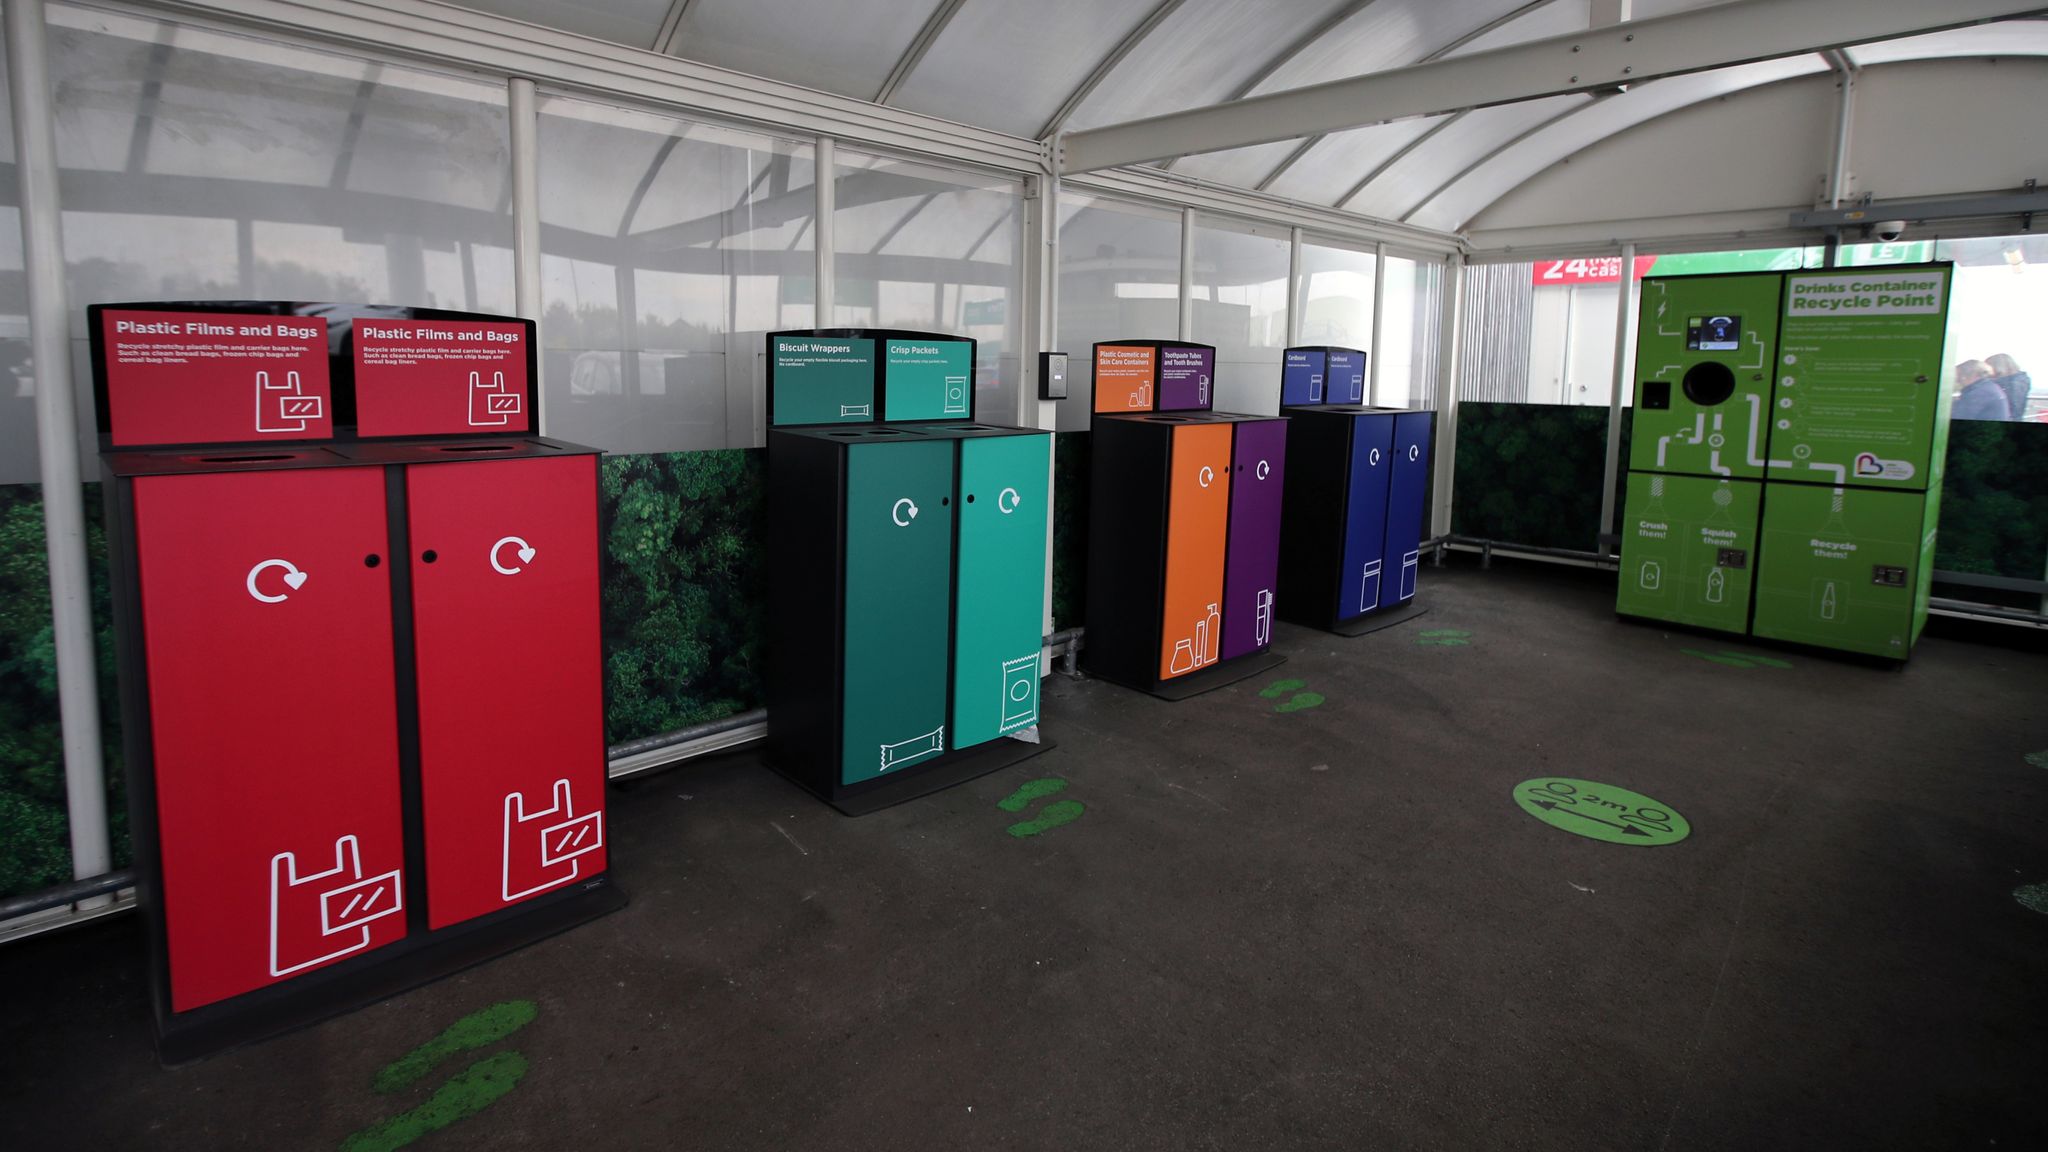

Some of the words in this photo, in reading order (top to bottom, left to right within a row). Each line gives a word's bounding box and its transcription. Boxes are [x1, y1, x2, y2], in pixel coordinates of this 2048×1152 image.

[1543, 258, 1588, 279] 24
[1589, 263, 1622, 277] cas
[1794, 283, 1846, 294] Drinks
[1850, 280, 1937, 292] Container
[1793, 295, 1871, 311] Recycle
[1877, 294, 1935, 308] Point
[116, 321, 181, 335] Plastic
[186, 322, 235, 336] Films
[239, 324, 272, 337] and
[277, 325, 318, 339] Bags
[363, 327, 412, 340] Plastic
[416, 328, 454, 341] Films
[457, 330, 483, 342] and
[487, 331, 519, 344] Bags
[779, 343, 808, 352] Biscuit
[811, 344, 850, 354] Wrappers
[891, 346, 910, 355] Crisp
[912, 346, 939, 354] Packets
[1165, 352, 1188, 360] Toothpaste
[1640, 521, 1668, 531] Crush
[1639, 529, 1666, 539] them!
[1701, 528, 1736, 539] Squish
[1704, 537, 1733, 547] them!
[1810, 539, 1857, 551] Recycle
[1814, 549, 1848, 559] them!
[1582, 794, 1629, 812] 2m
